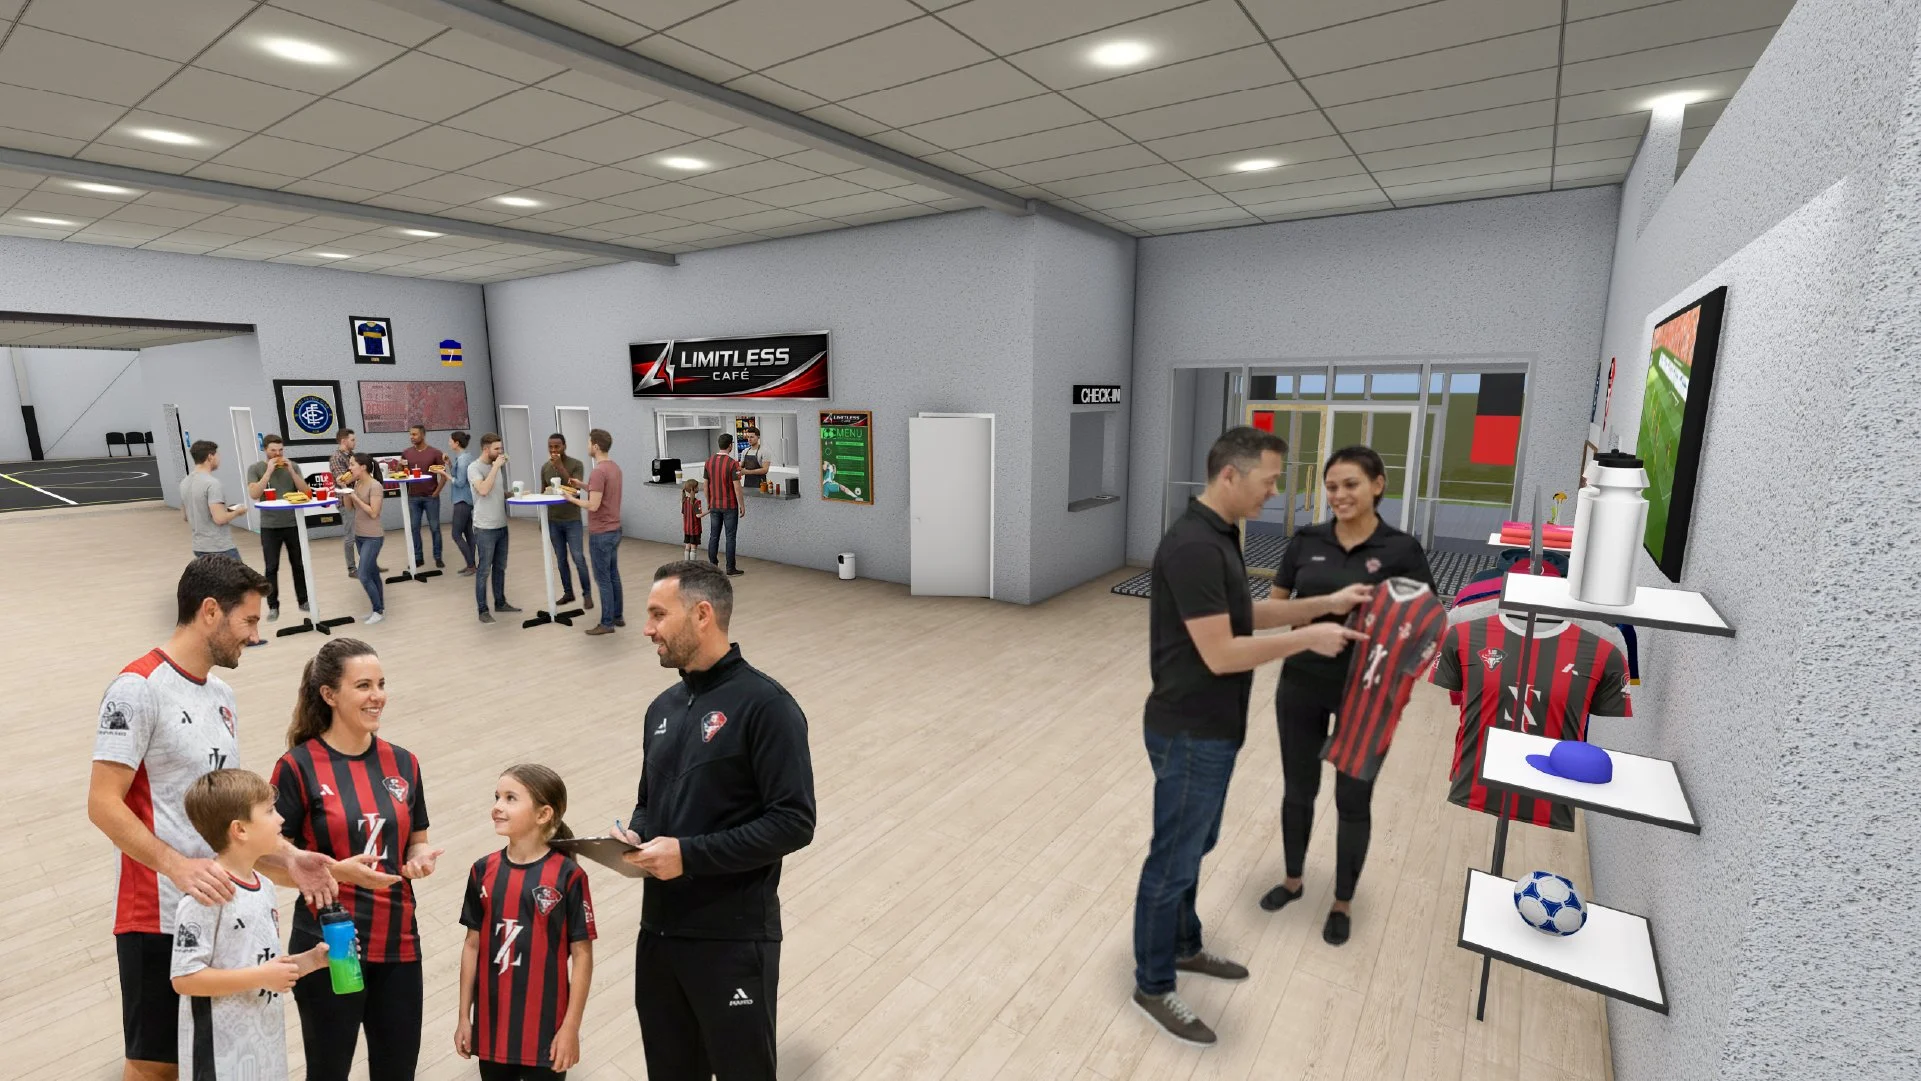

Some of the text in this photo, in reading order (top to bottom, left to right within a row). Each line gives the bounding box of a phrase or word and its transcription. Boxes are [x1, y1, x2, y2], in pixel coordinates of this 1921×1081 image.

[447, 349, 455, 363] 7
[680, 347, 790, 368] LIMITLESS
[712, 368, 750, 381] CAFÉ
[1081, 388, 1121, 403] CHECK-IN
[836, 428, 863, 438] MENU
